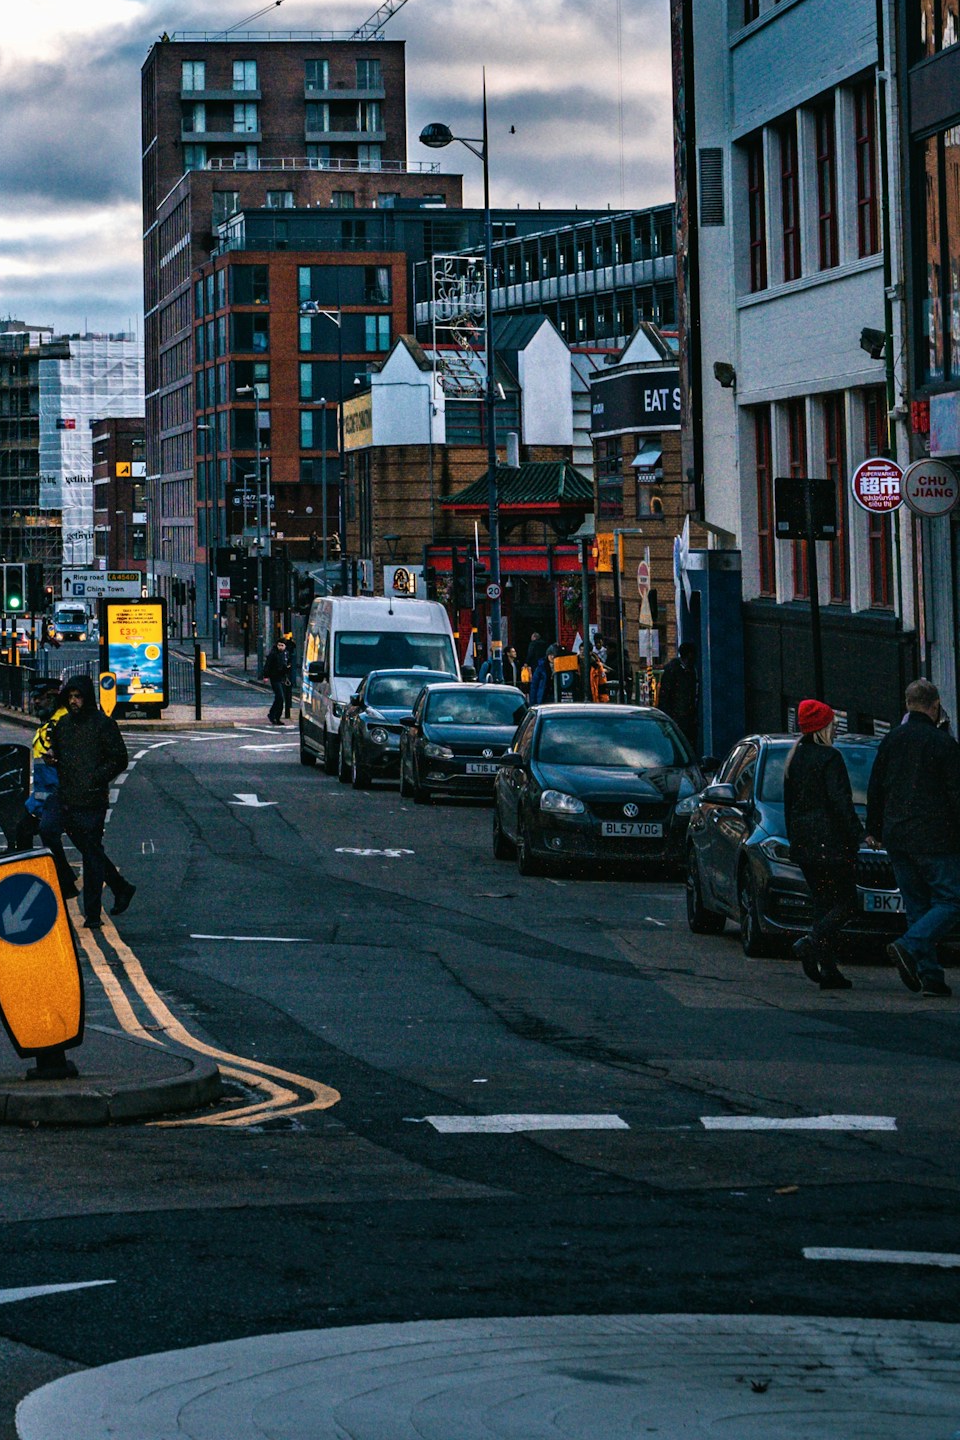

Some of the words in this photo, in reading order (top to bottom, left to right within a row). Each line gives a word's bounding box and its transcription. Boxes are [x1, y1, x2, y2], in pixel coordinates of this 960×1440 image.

[644, 388, 669, 412] EAT
[860, 477, 900, 495] 超市
[917, 476, 947, 486] CHU
[912, 488, 954, 498] JIANG
[107, 573, 139, 581] (A4540)
[488, 587, 500, 595] 20
[606, 823, 634, 834] BL57
[873, 895, 901, 910] BK7
